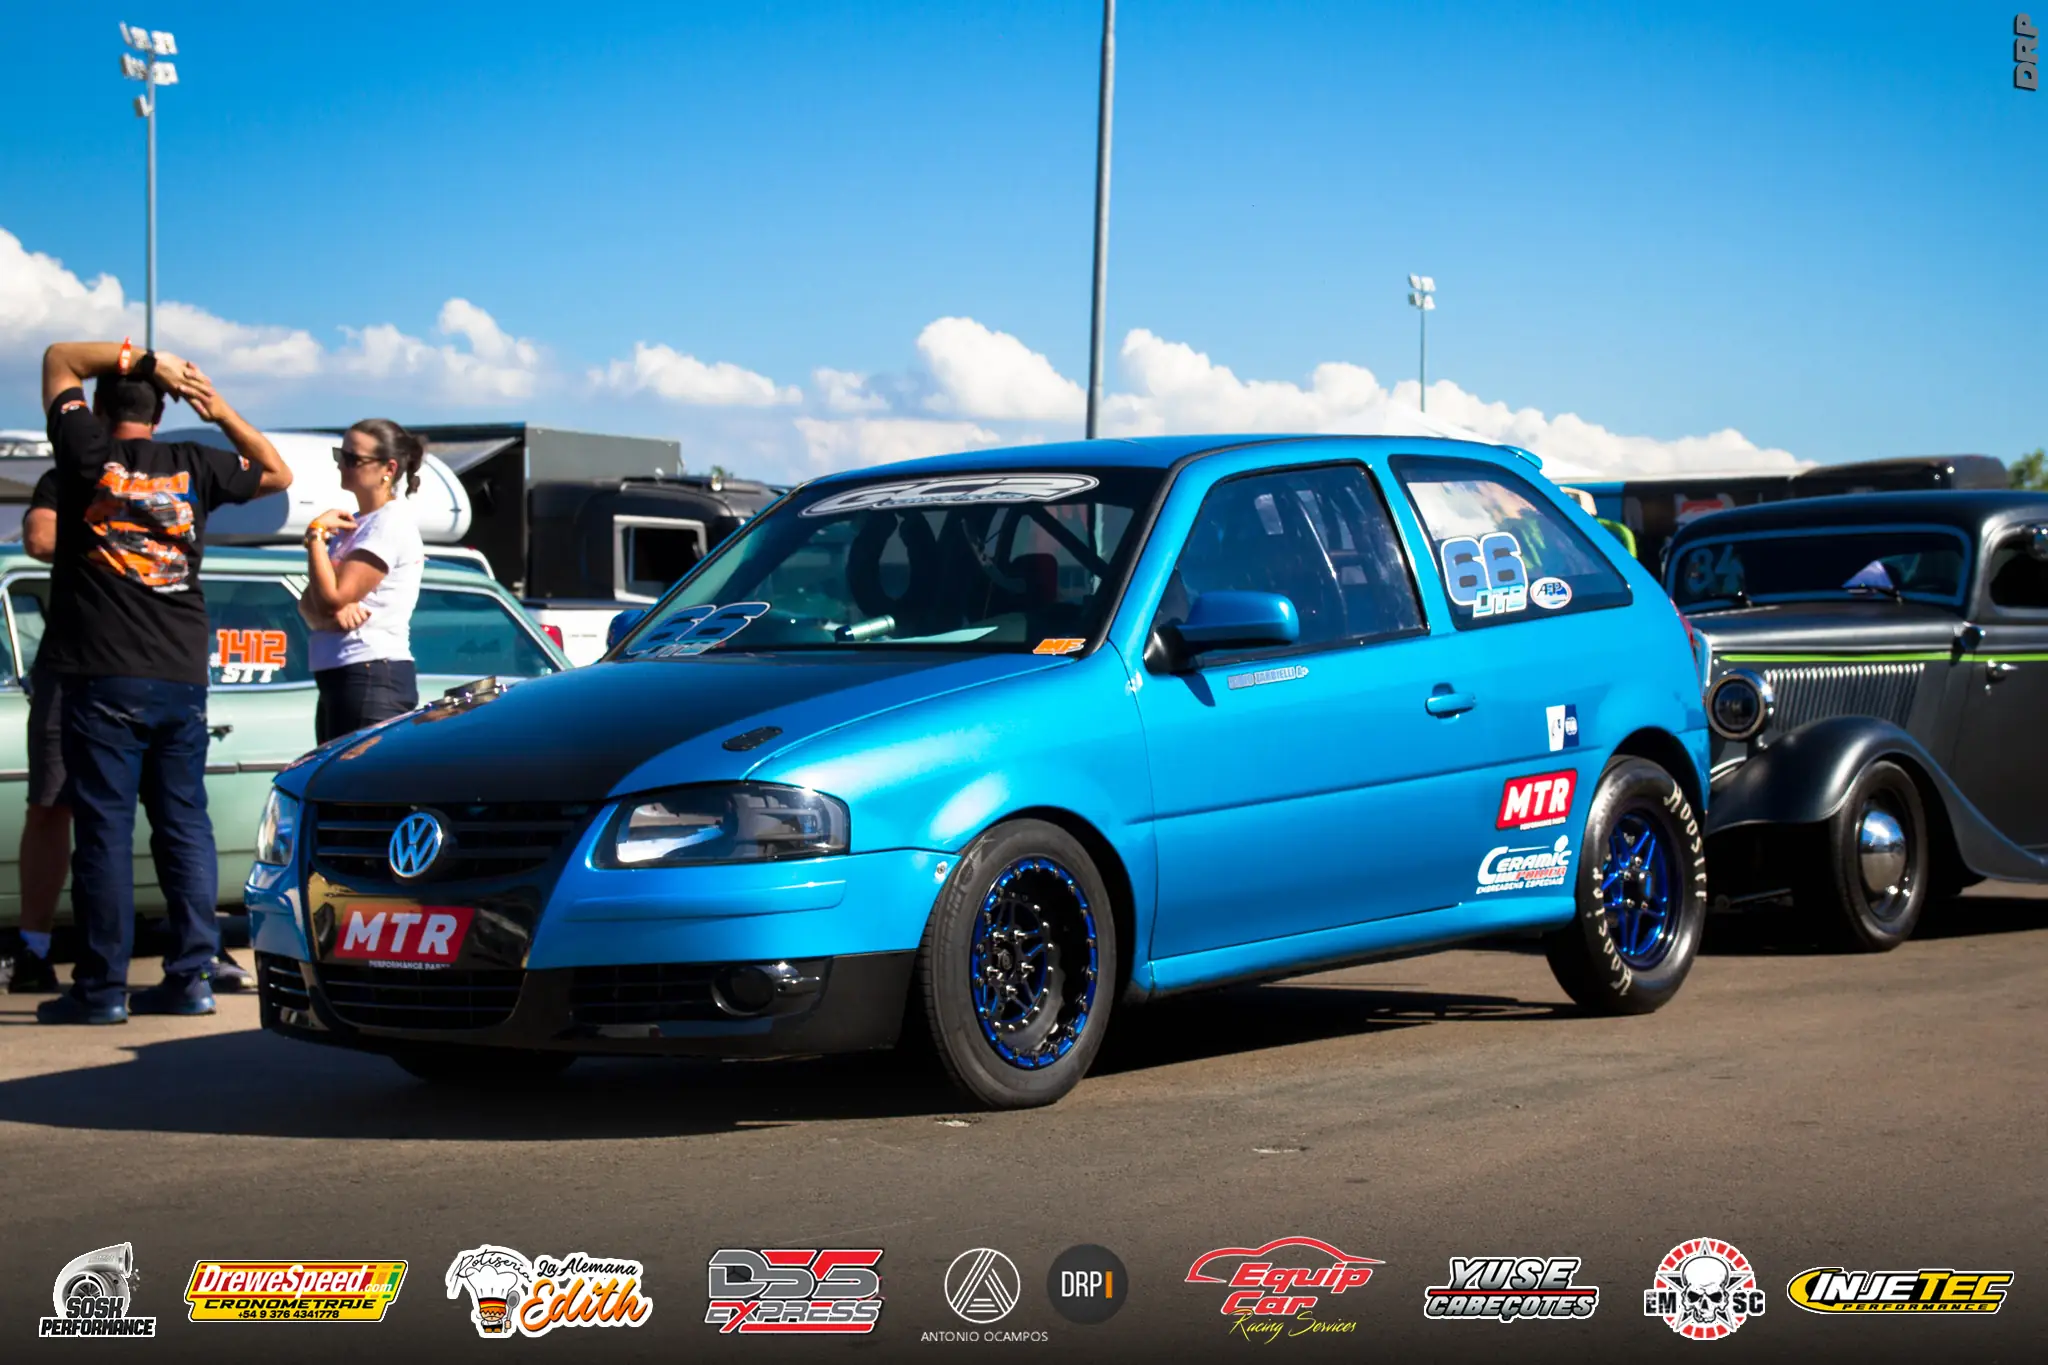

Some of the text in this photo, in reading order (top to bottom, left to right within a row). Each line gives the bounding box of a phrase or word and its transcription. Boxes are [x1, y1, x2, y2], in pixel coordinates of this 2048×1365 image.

[1441, 532, 1528, 605] 66
[625, 601, 771, 655] 66
[221, 663, 281, 683] STT
[1503, 778, 1570, 821] MTR
[343, 911, 458, 955] MTR
